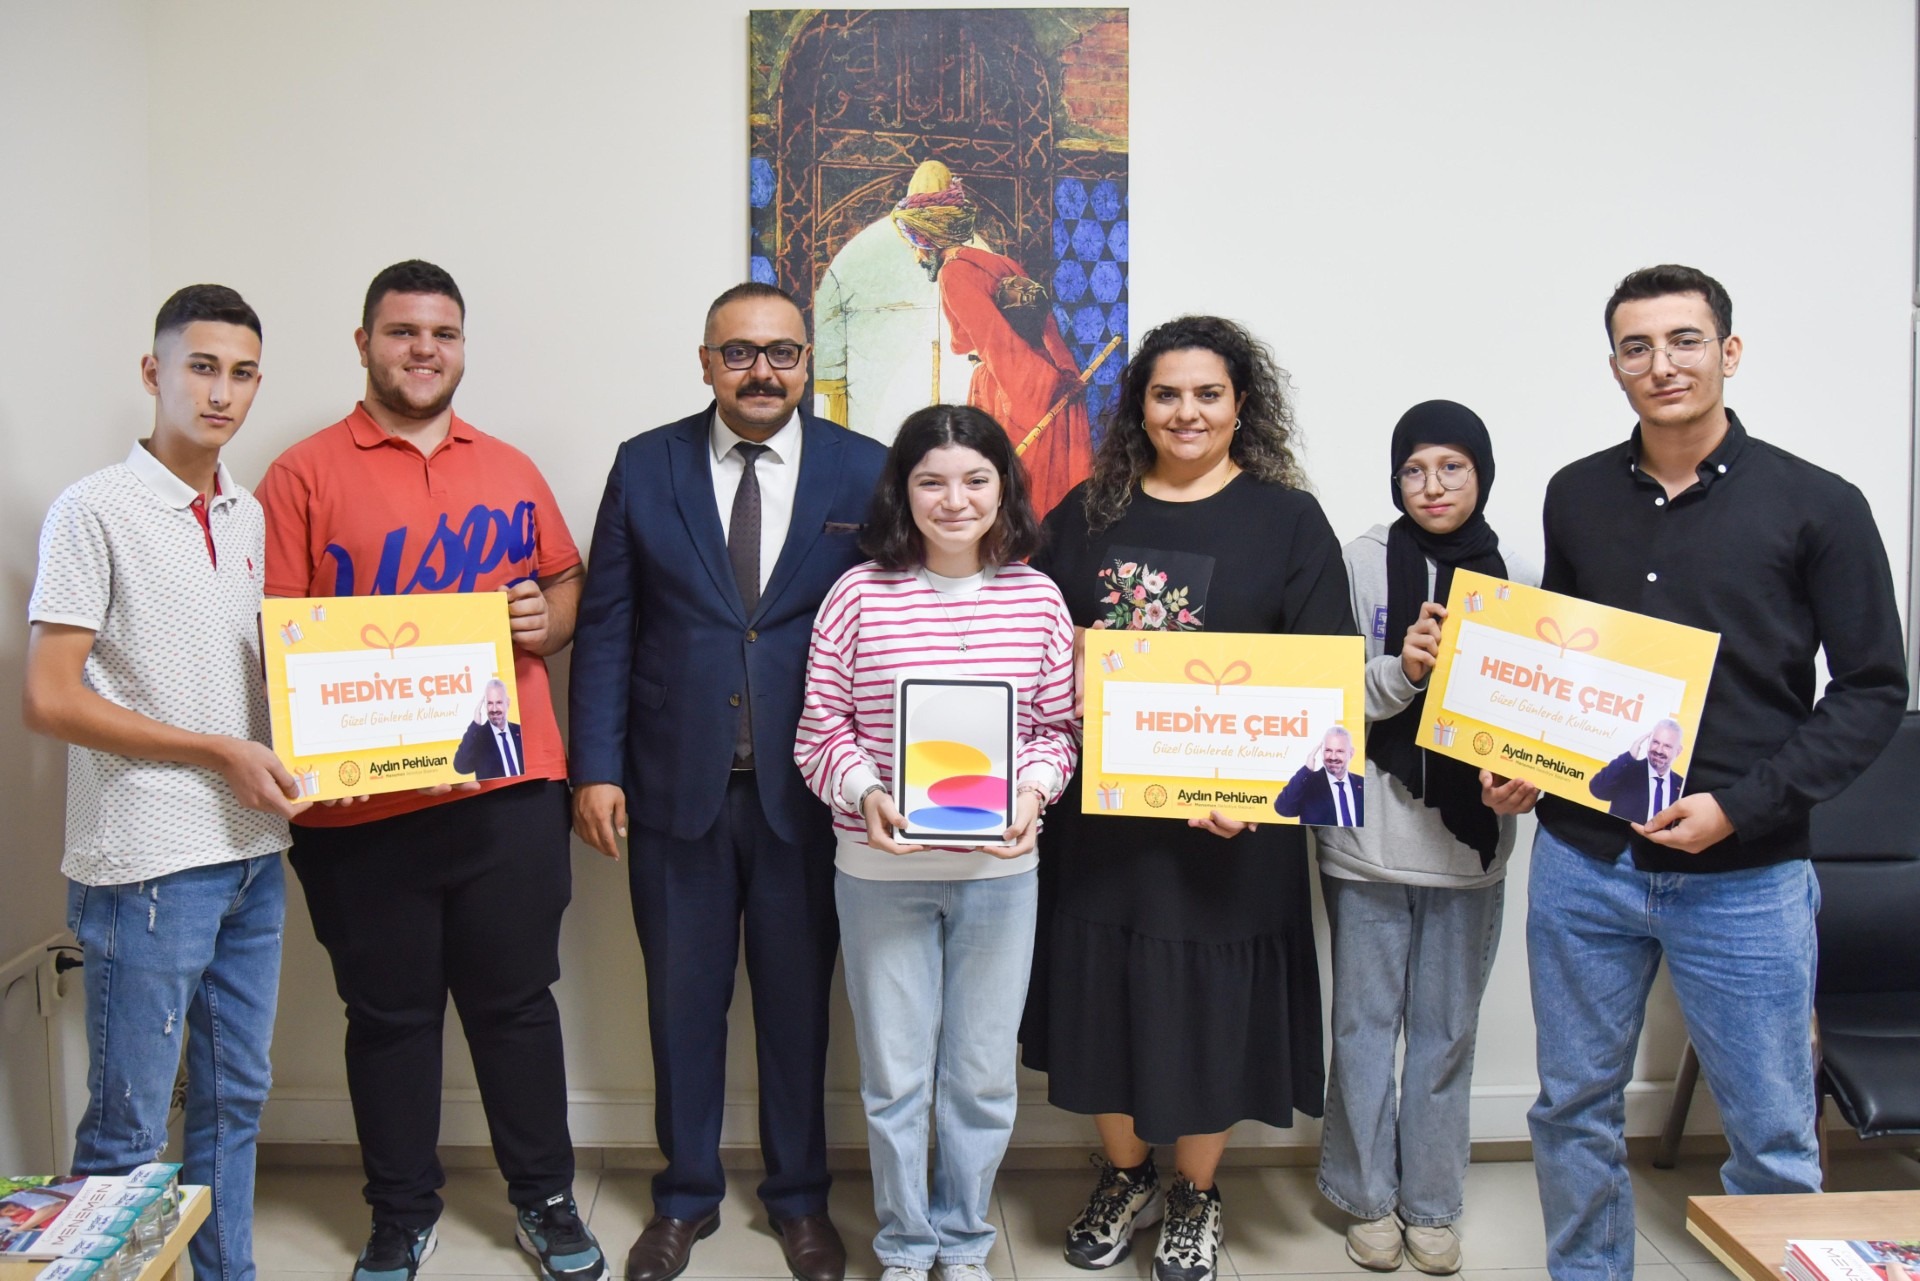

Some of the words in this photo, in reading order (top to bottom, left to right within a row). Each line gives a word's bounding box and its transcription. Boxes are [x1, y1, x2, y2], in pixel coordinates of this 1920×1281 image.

[321, 672, 414, 705] HEDİYE
[418, 665, 473, 704] ÇEKİ
[1480, 656, 1574, 702] HEDİYE
[1578, 686, 1645, 723] ÇEKİ
[341, 713, 367, 728] Güzel
[370, 711, 413, 726] Günlerde
[416, 704, 459, 722] Kullanın!
[1135, 705, 1237, 735] HEDİYE
[1243, 709, 1308, 742] ÇEKİ
[1490, 690, 1517, 708] Güzel
[1518, 699, 1563, 724] Günlerde
[1565, 714, 1618, 740] Kullanın!
[369, 760, 400, 776] Aydın
[402, 755, 448, 770] Pehlivan
[1152, 741, 1182, 755] Güzel
[1184, 742, 1234, 757] Günlerde
[1237, 745, 1289, 760] Kullanın!
[1502, 743, 1533, 763] Aydın
[1535, 754, 1585, 780] Pehlivan
[1177, 789, 1212, 804] Aydın
[1215, 790, 1268, 805] Pehlivan
[51, 1184, 113, 1245] MENEMEN
